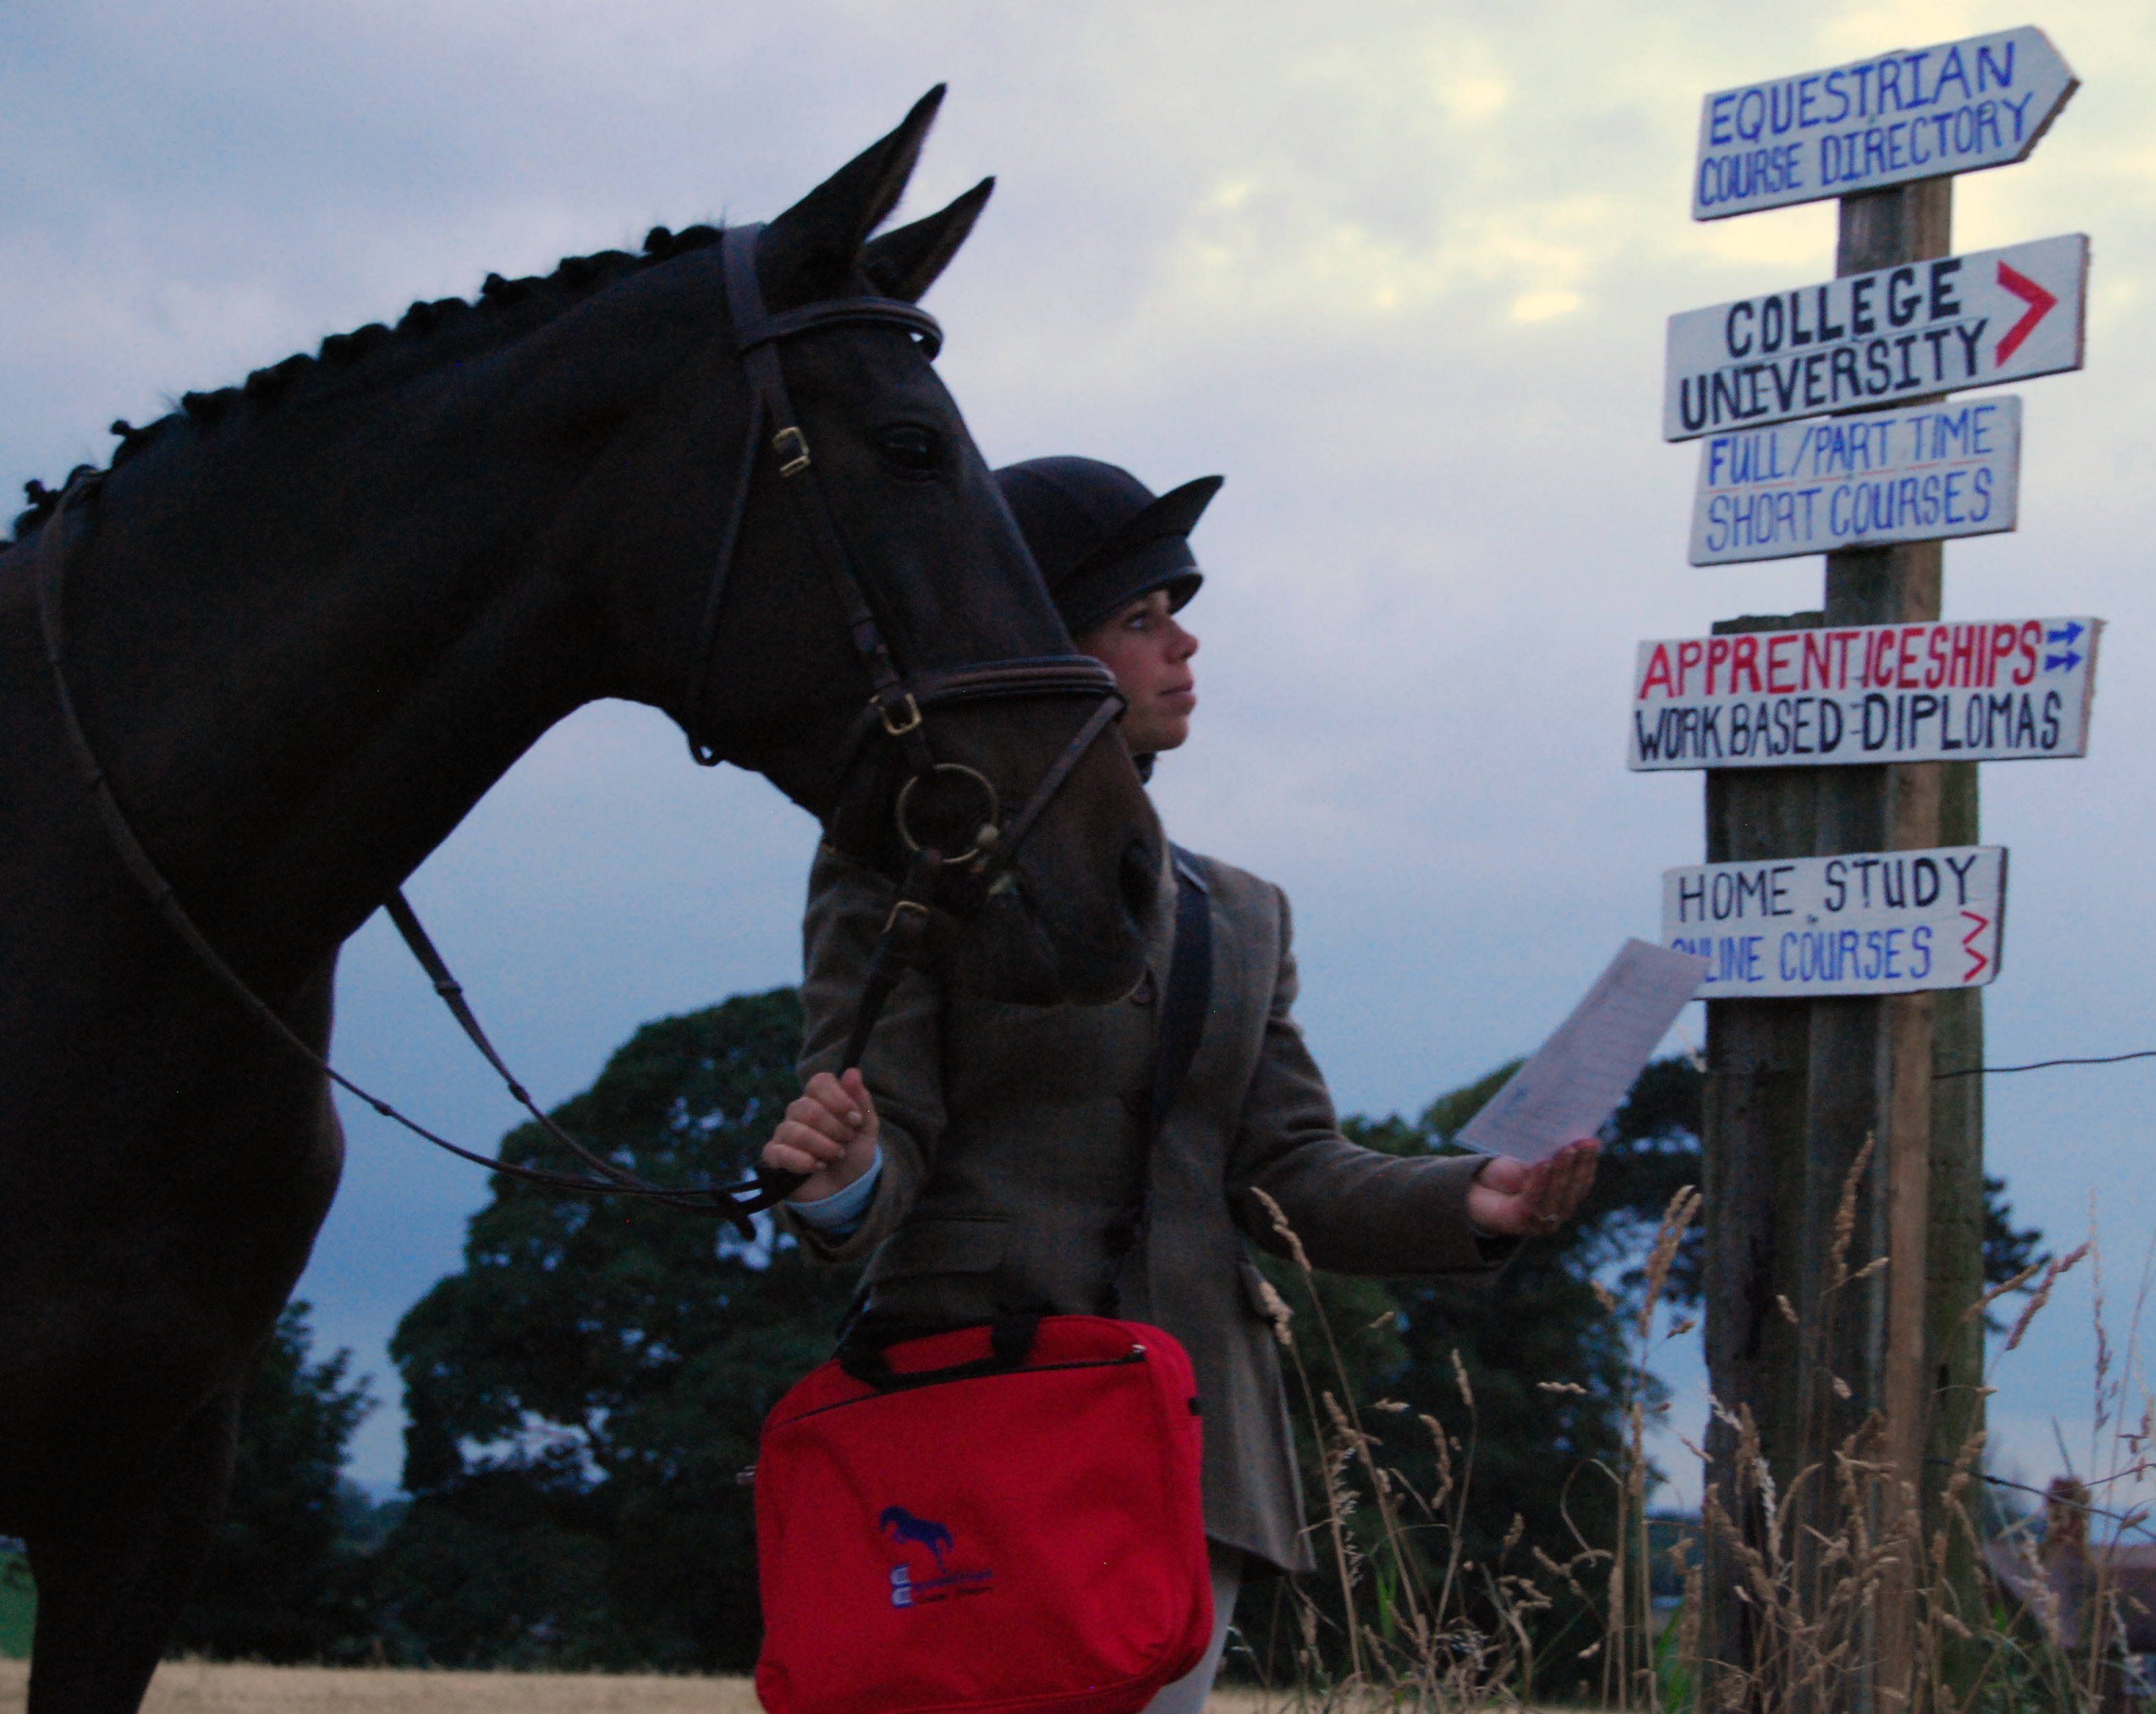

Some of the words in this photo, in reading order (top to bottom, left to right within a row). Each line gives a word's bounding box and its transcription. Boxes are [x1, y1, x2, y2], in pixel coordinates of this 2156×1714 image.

[1709, 41, 2016, 146] EQUESTRIAN
[1698, 142, 1805, 207] COURSE
[1821, 91, 2034, 186] DIRECTORY
[1726, 258, 1963, 358] COLLEGE
[1680, 318, 1989, 431] UNIVERSITY
[1907, 405, 1997, 460] TIME
[1707, 488, 1822, 552] SHORT
[1830, 467, 1994, 538] COURSES
[1639, 620, 2041, 699] APPRENTICESHIPS
[1861, 690, 2062, 752] DIPLOMAS
[1678, 866, 1796, 923] HOME
[1824, 854, 1978, 912] STUDY
[1672, 935, 1764, 983] LINE
[1779, 925, 1933, 982] COURSES
